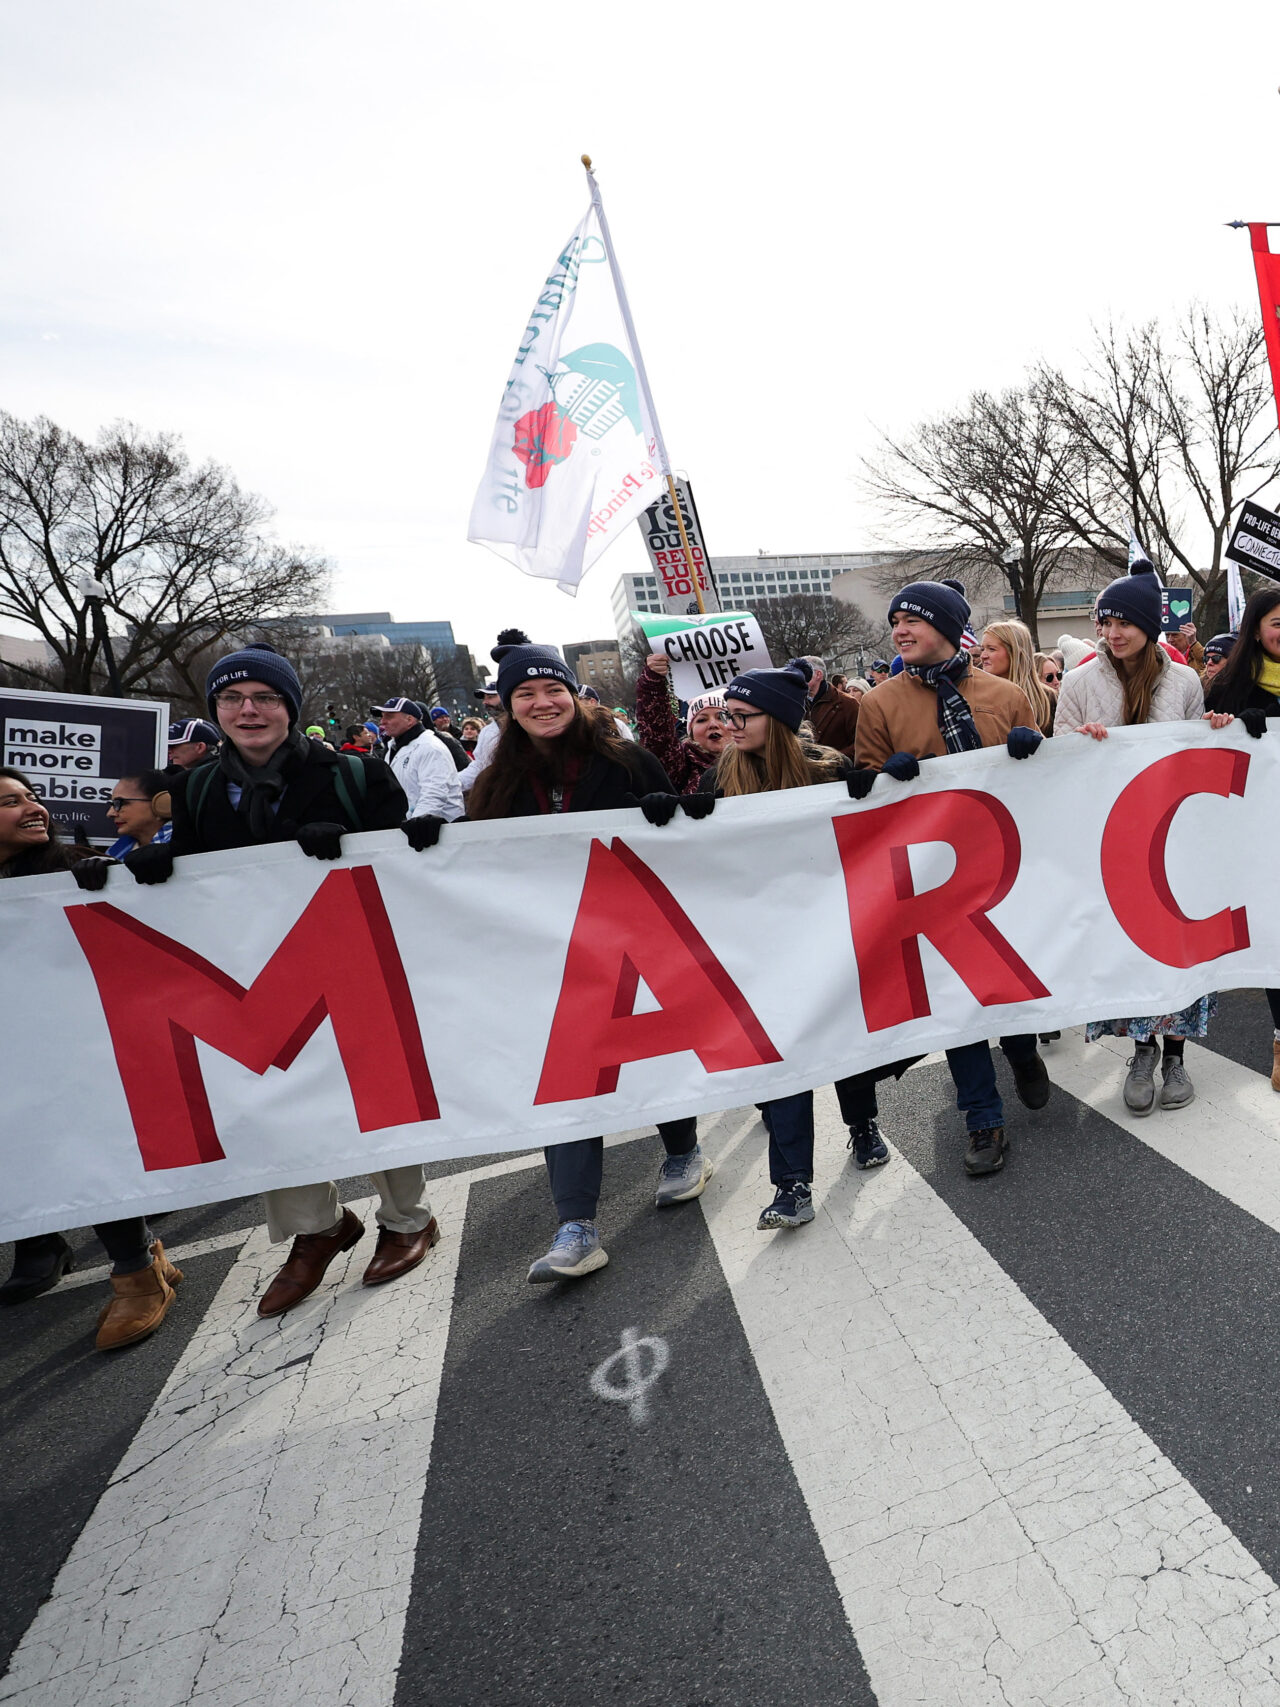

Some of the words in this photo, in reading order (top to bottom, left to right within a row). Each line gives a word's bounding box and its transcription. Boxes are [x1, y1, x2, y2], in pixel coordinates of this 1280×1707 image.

[645, 504, 693, 535] IS
[1243, 513, 1270, 534] PRO-LIFE
[649, 532, 699, 551] OUR
[658, 561, 705, 581] LUT
[908, 603, 921, 612] FOR
[921, 608, 935, 620] LIFE
[1112, 610, 1123, 618] LIFE
[664, 622, 754, 663] CHOOSE
[216, 674, 229, 686] FOR
[230, 670, 249, 679] LIFE
[538, 667, 553, 675] FOR
[554, 669, 567, 680] LIF
[695, 659, 741, 690] LIFE
[737, 686, 752, 697] LIFE
[690, 697, 728, 713] PRO-LIFE
[9, 725, 96, 748] make
[8, 751, 93, 770] more
[31, 777, 113, 801] abies
[52, 811, 91, 824] erylife
